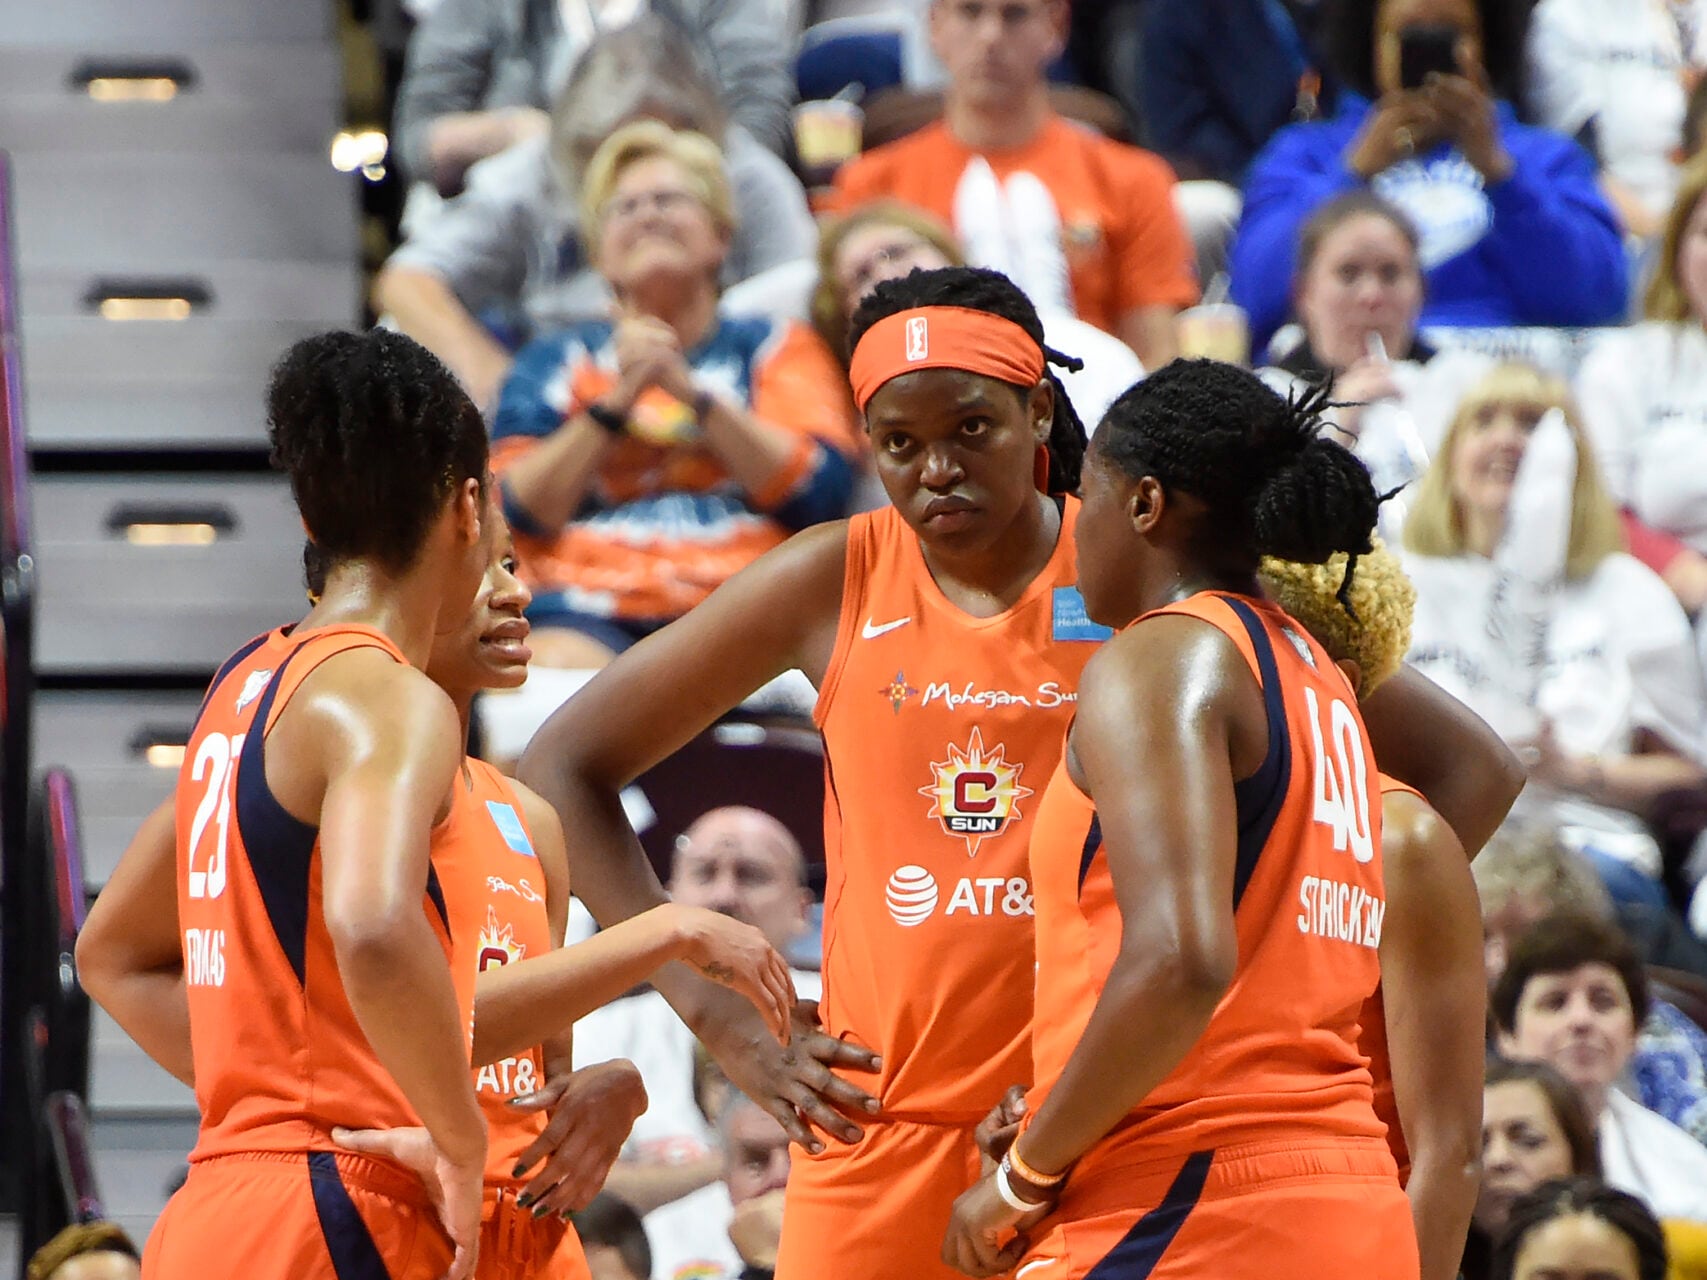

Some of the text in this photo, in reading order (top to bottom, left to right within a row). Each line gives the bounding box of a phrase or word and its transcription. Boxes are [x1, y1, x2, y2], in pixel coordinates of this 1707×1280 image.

[922, 682, 1031, 711] Mohegan
[954, 772, 998, 813] C
[1304, 686, 1374, 863] 40
[951, 818, 997, 831] SUN
[945, 877, 1036, 916] AT&
[476, 1057, 541, 1096] AT&
